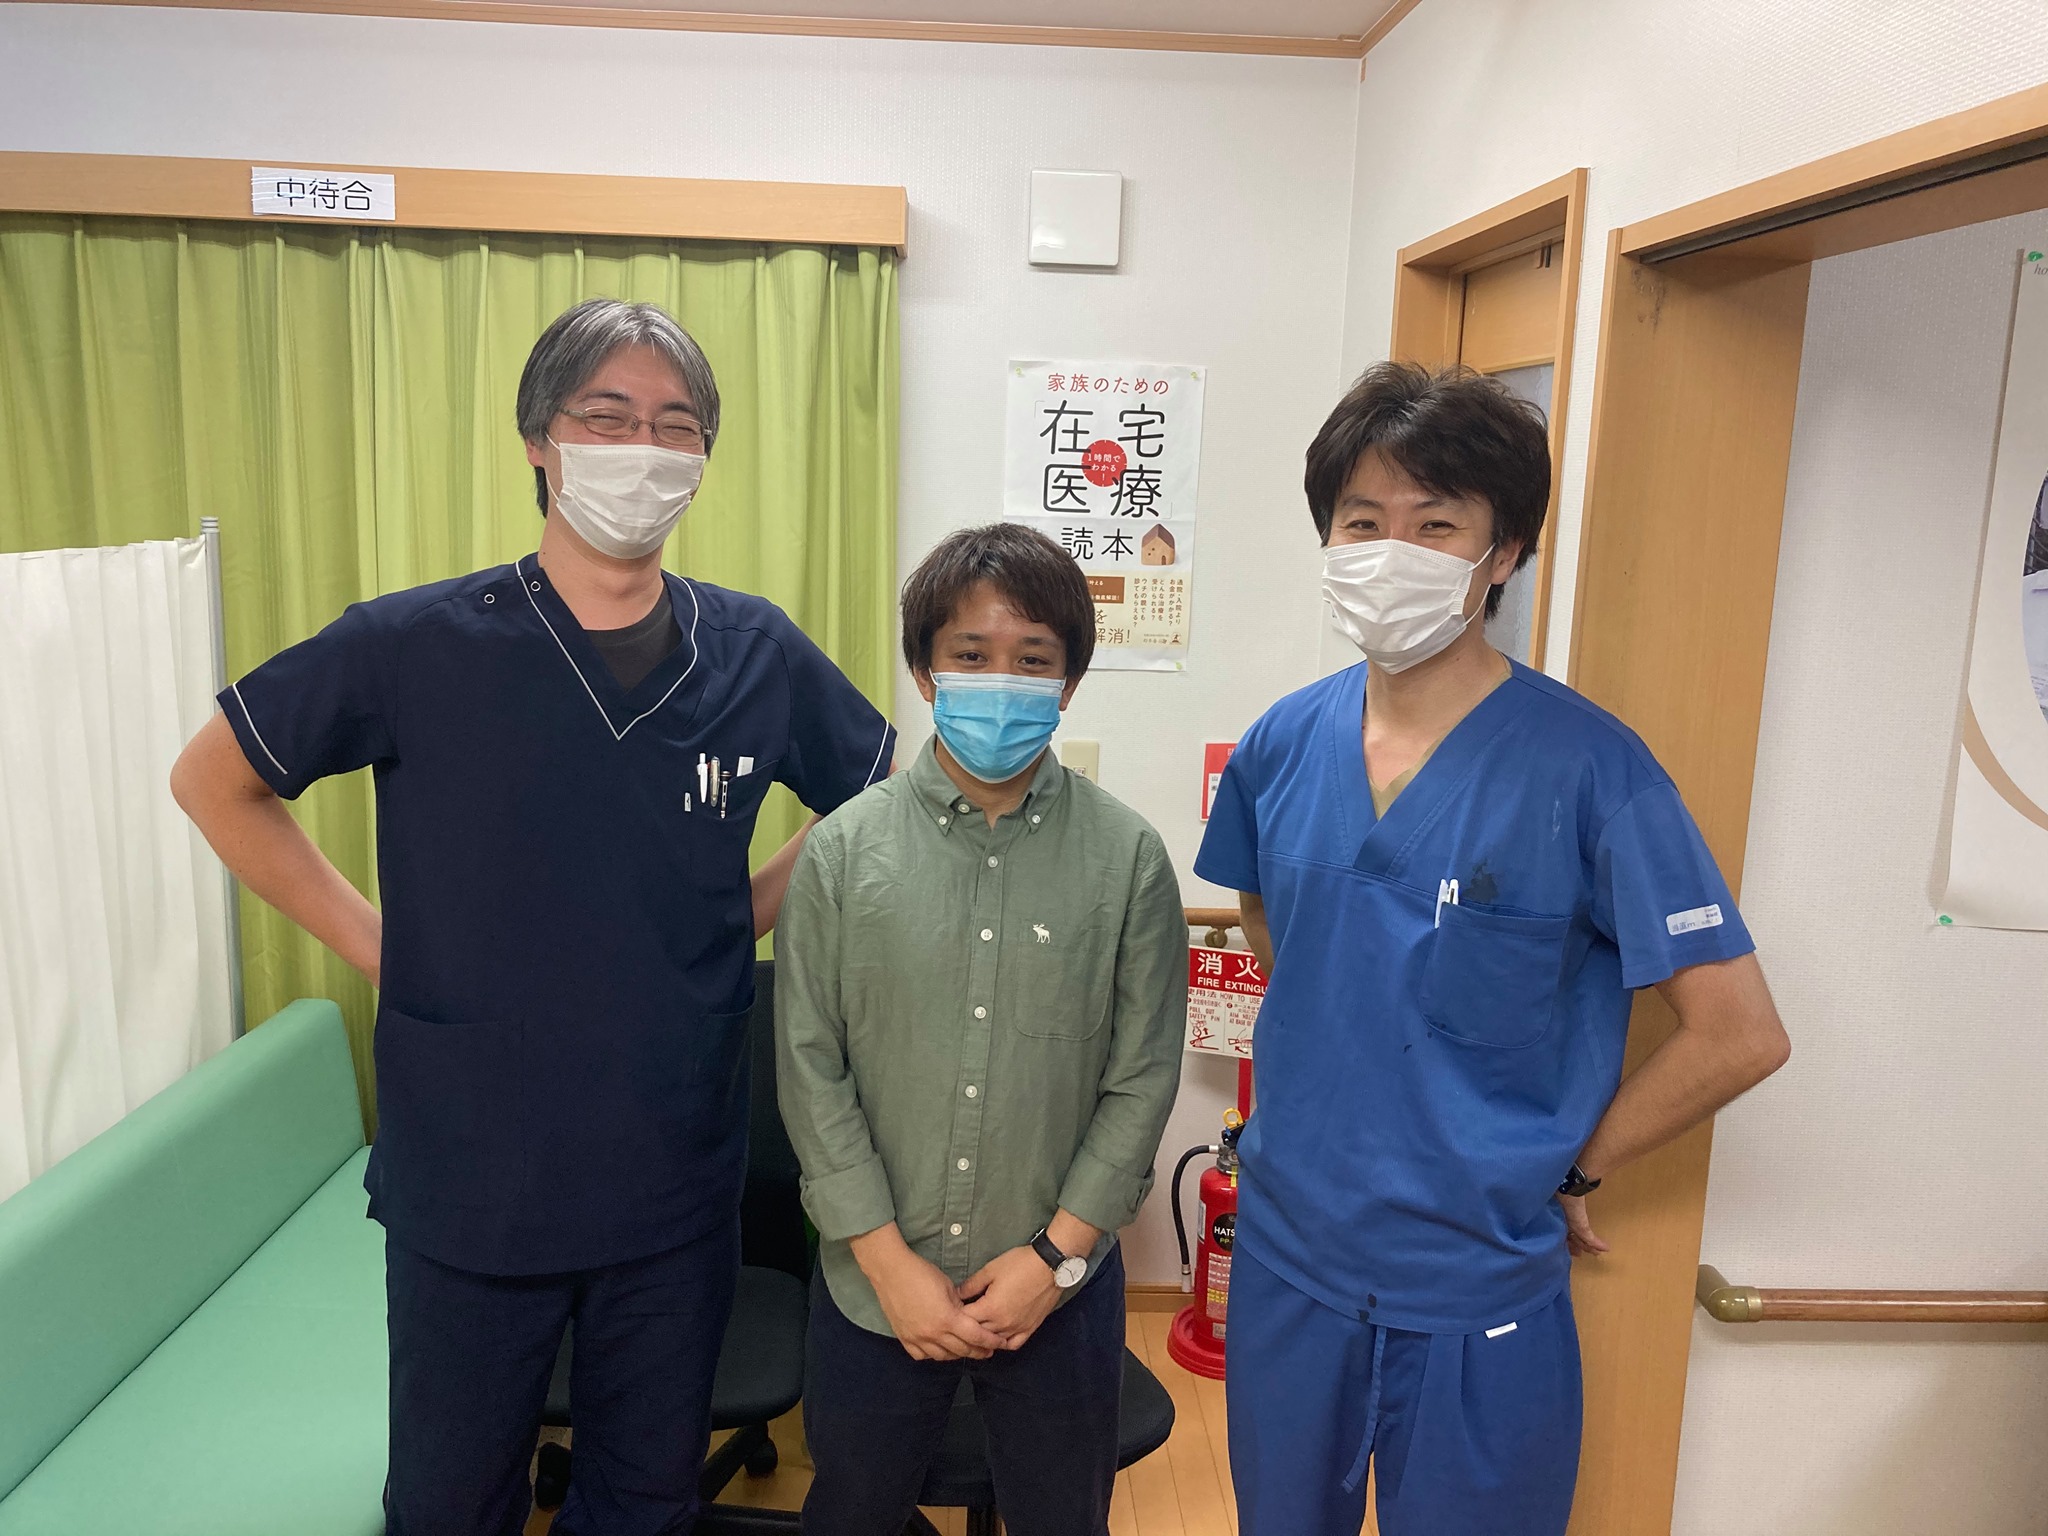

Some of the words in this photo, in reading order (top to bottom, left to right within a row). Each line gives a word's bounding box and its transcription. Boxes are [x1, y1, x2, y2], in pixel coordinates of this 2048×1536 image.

[276, 177, 373, 211] 中待合
[1047, 372, 1169, 396] 家族のための
[1087, 453, 1121, 463] 1時間で
[1091, 463, 1117, 472] わかる
[1061, 526, 1135, 562] 読本
[1096, 609, 1107, 624] を
[1198, 952, 1261, 981] 消火
[1197, 976, 1220, 988] FIRE
[1220, 993, 1233, 1001] HOW
[1237, 995, 1246, 1003] TO
[1249, 997, 1261, 1005] USE
